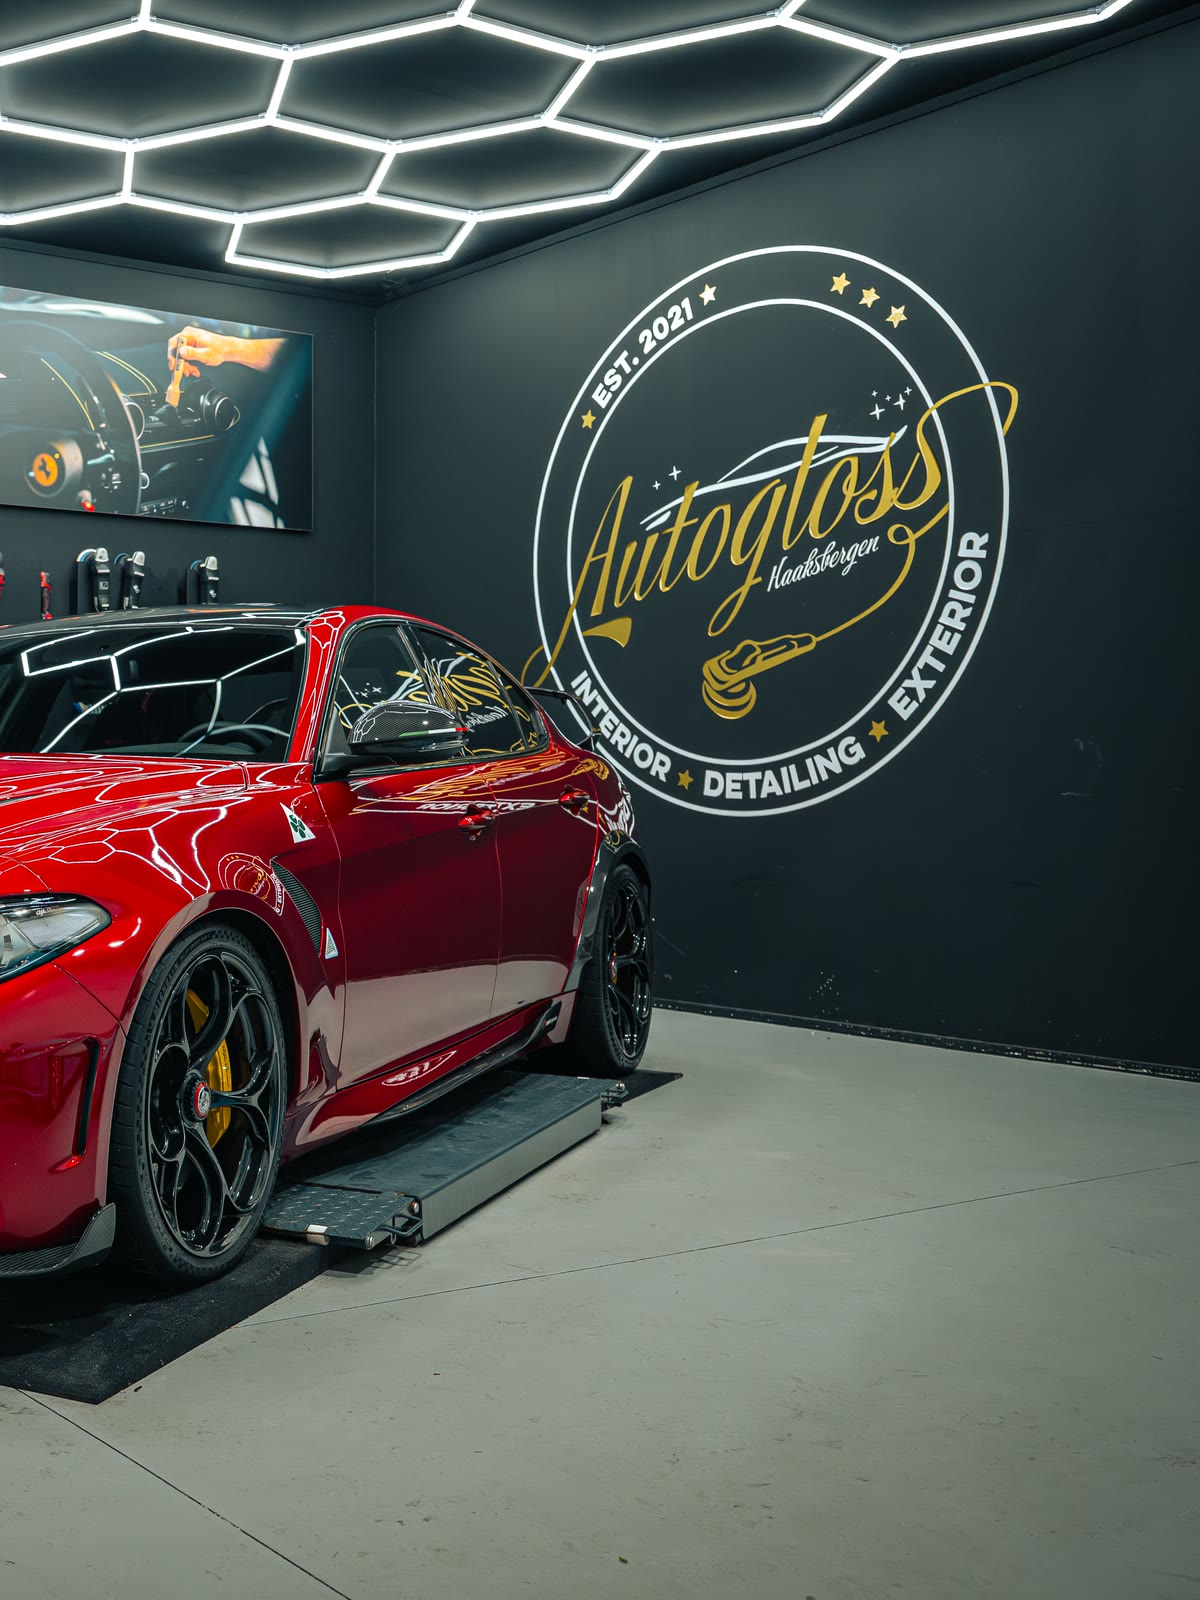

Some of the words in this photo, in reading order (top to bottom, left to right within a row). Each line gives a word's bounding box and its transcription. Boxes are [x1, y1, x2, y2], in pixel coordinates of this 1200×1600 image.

[591, 349, 640, 409] EST.
[638, 296, 694, 355] 2021
[557, 398, 955, 643] Autogloss
[766, 534, 880, 593] Haaksbergen
[570, 669, 672, 783] INTERIOR
[702, 734, 866, 801] DETAILING
[886, 530, 990, 722] EXTERIOR
